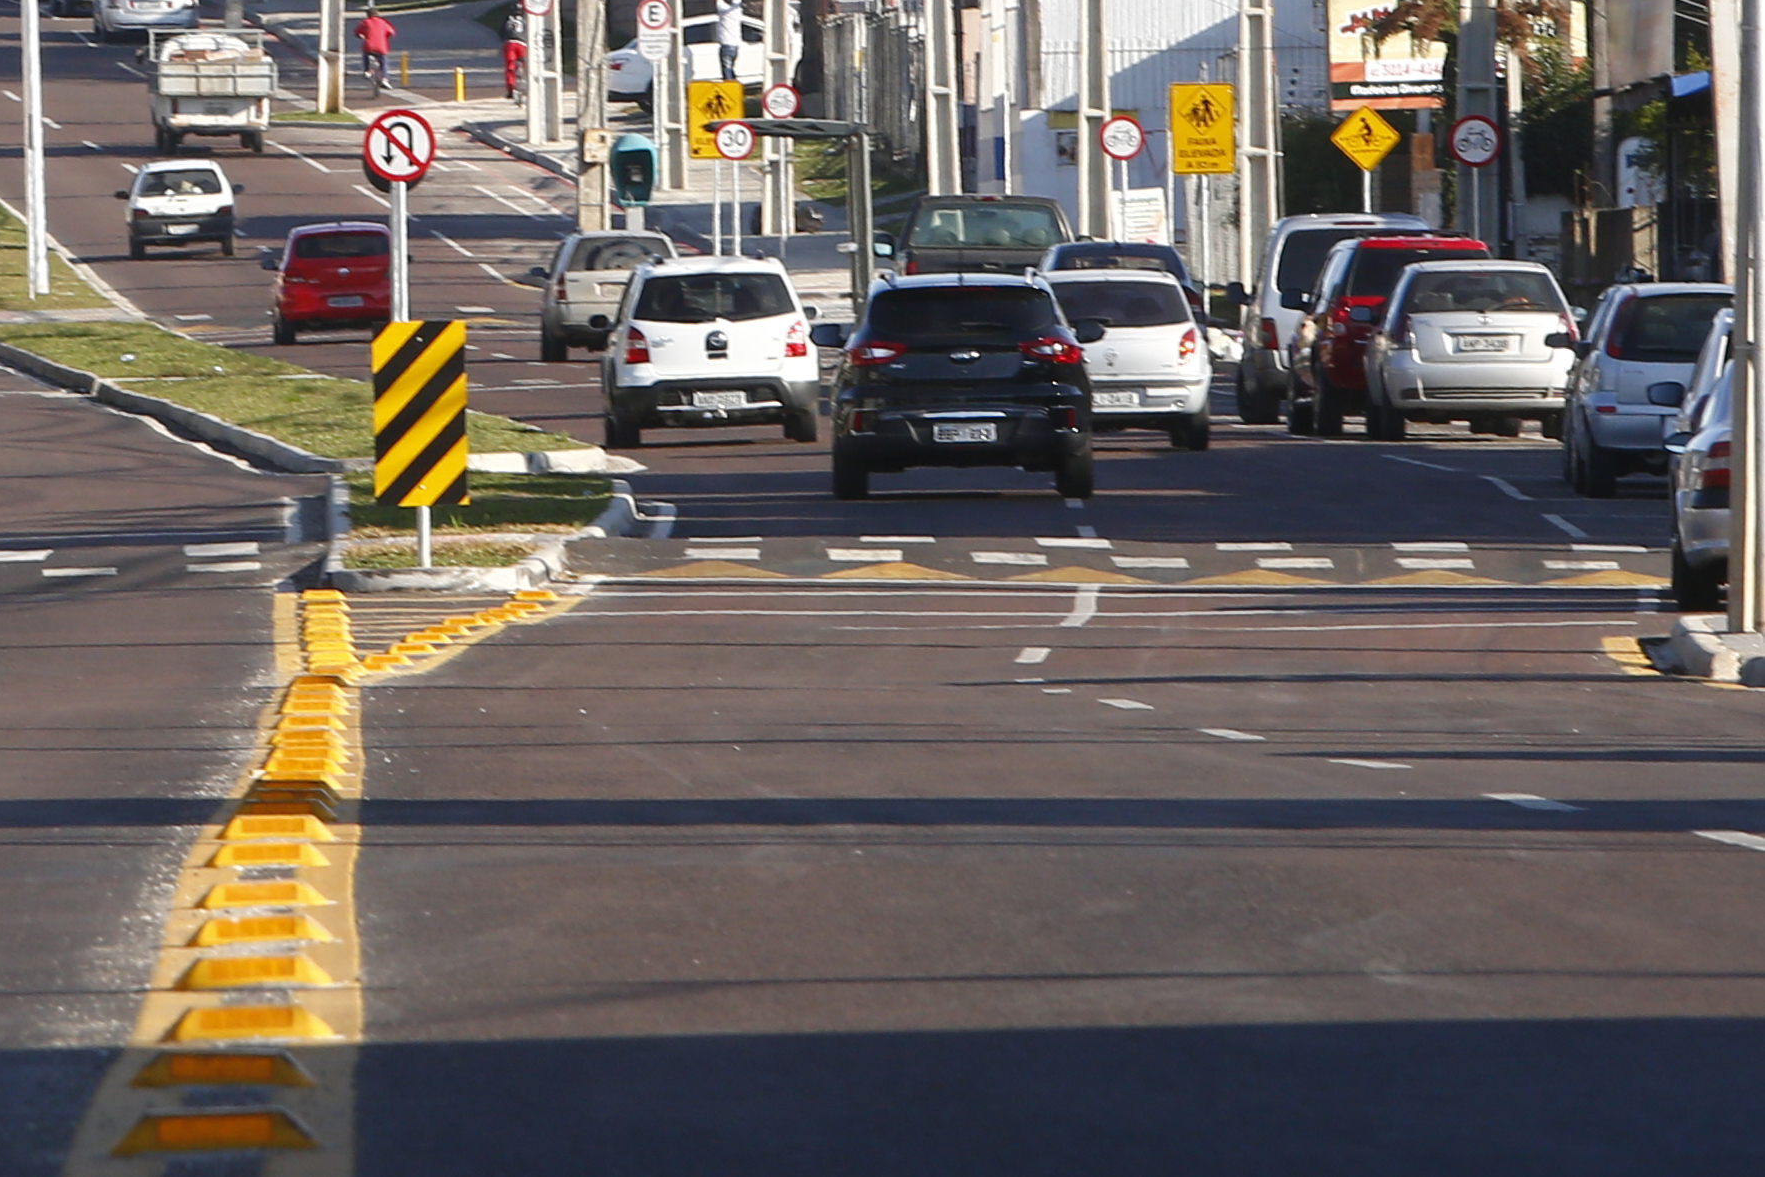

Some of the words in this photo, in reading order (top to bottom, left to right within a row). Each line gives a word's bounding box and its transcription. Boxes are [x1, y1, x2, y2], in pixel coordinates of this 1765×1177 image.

[648, 5, 661, 22] E
[722, 128, 748, 147] 30
[1187, 137, 1217, 146] FAIXA
[1178, 148, 1226, 158] ELEVADA
